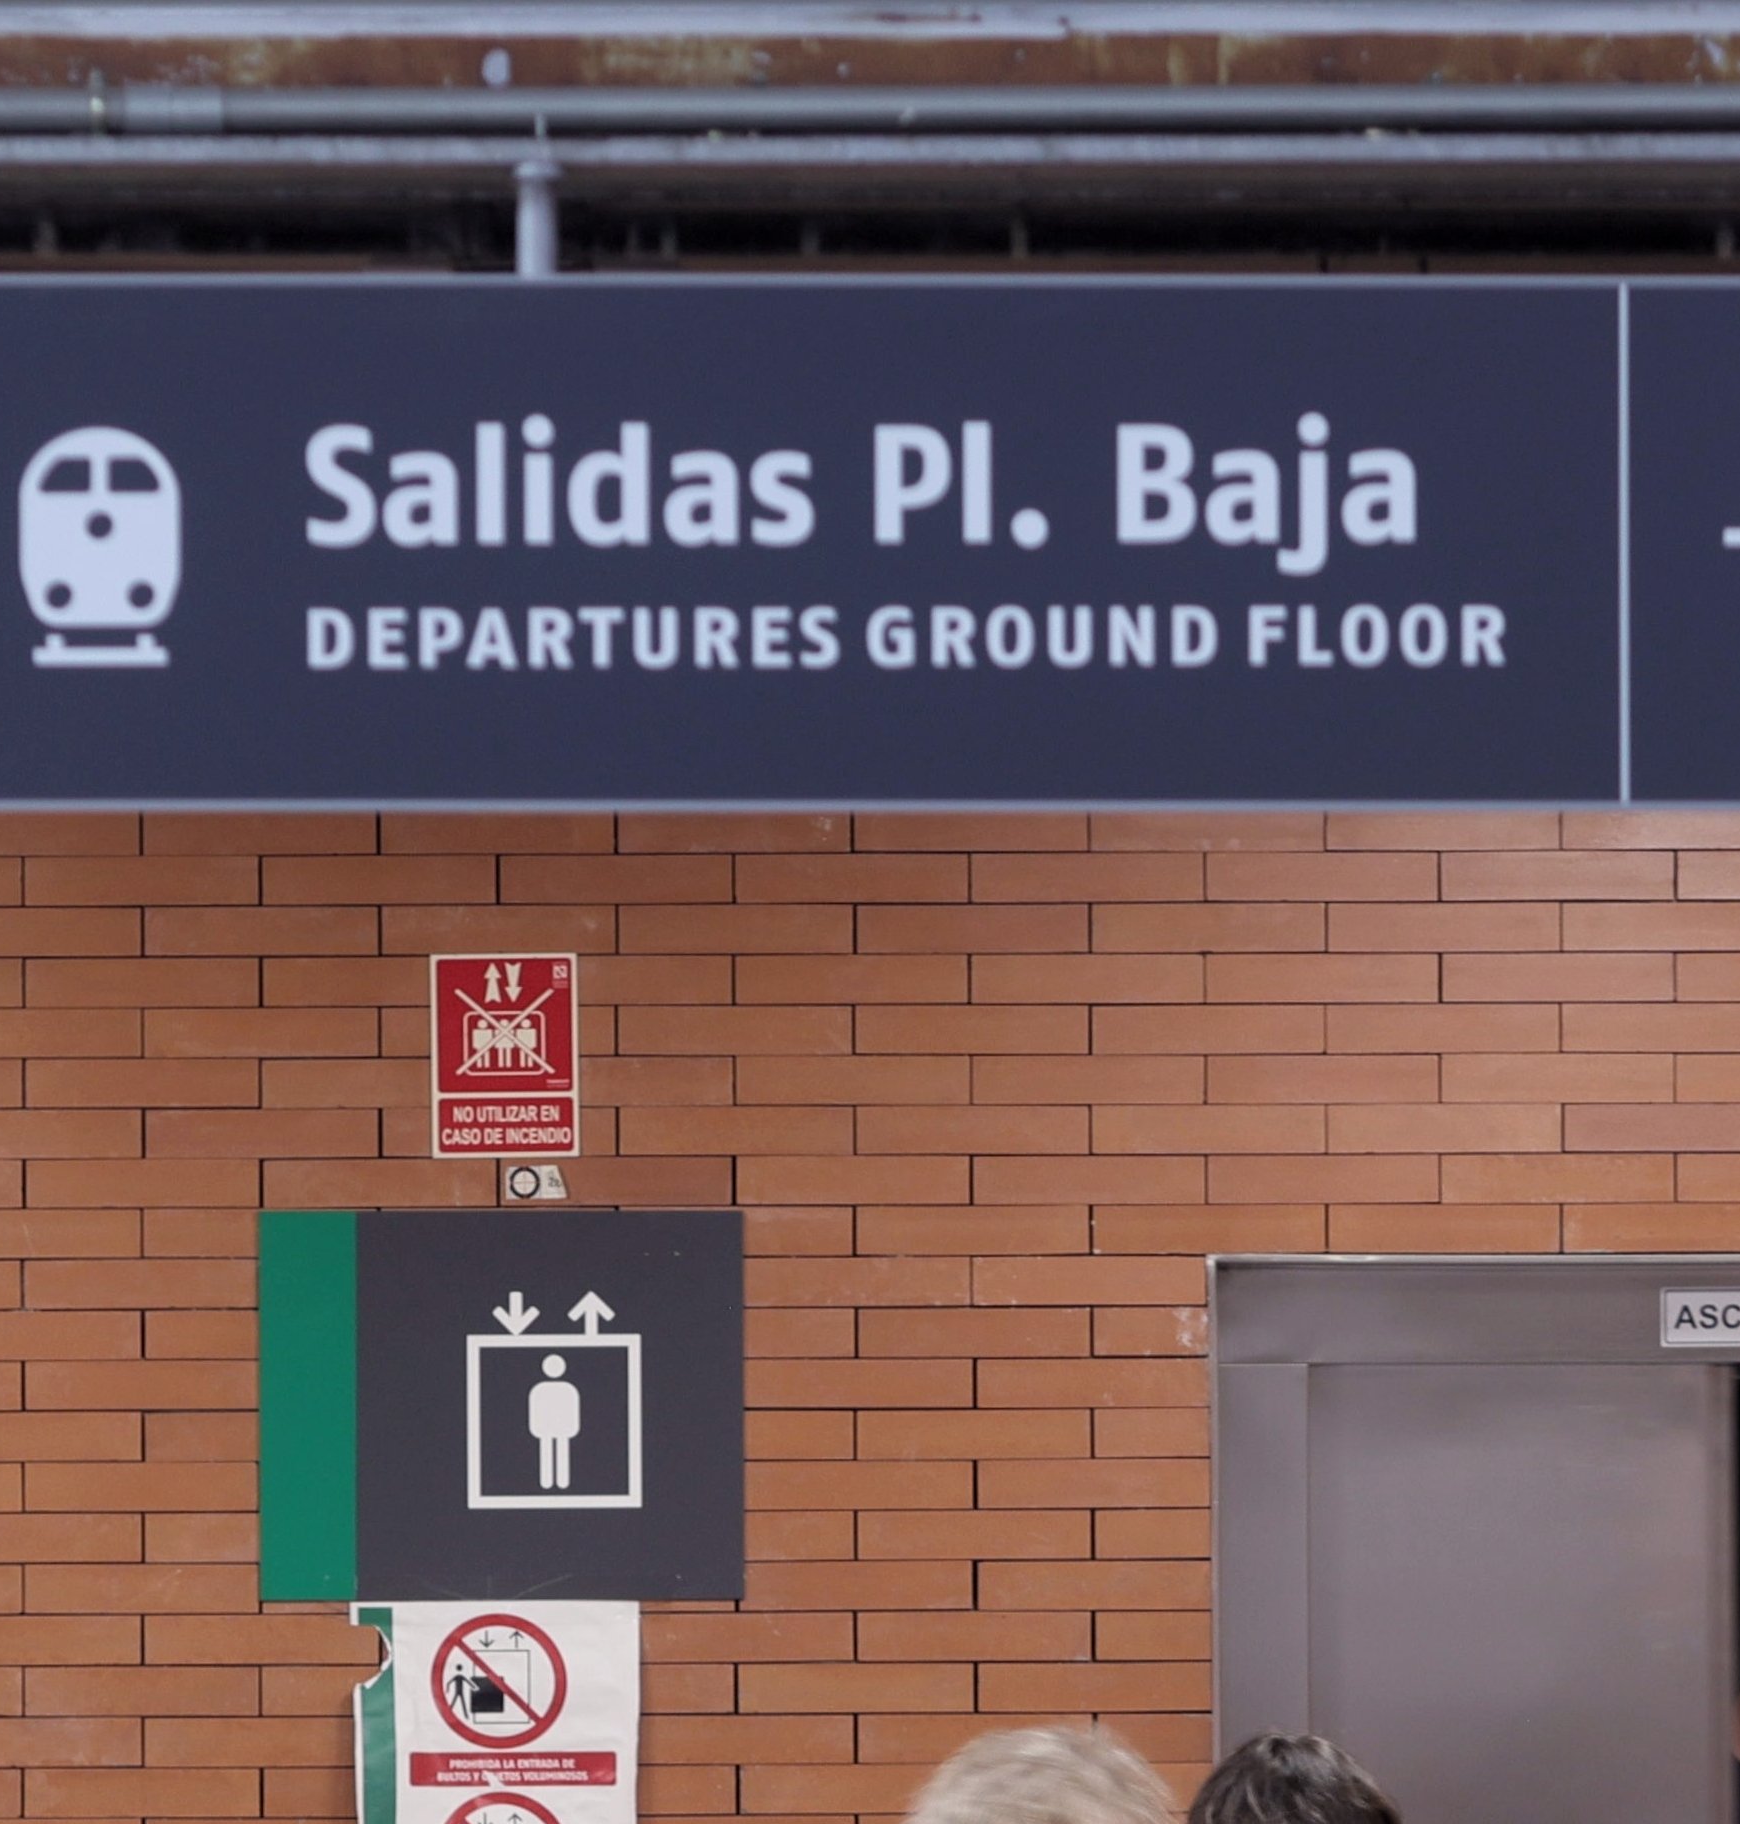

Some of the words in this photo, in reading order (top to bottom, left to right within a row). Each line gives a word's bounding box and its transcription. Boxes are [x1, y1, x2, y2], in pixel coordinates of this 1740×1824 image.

[305, 414, 815, 548] Salidas
[874, 420, 1049, 549] Pl.
[1116, 412, 1416, 575] Baja
[306, 605, 840, 670] DEPARTURES
[866, 604, 1218, 669] GROUND
[1248, 603, 1505, 667] FLOOR
[452, 1106, 474, 1123] NO
[476, 1105, 539, 1123] UTILIZAR
[540, 1105, 560, 1122] EN
[441, 1128, 482, 1146] CASO
[484, 1128, 504, 1145] DE
[506, 1127, 572, 1145] INCENDIO
